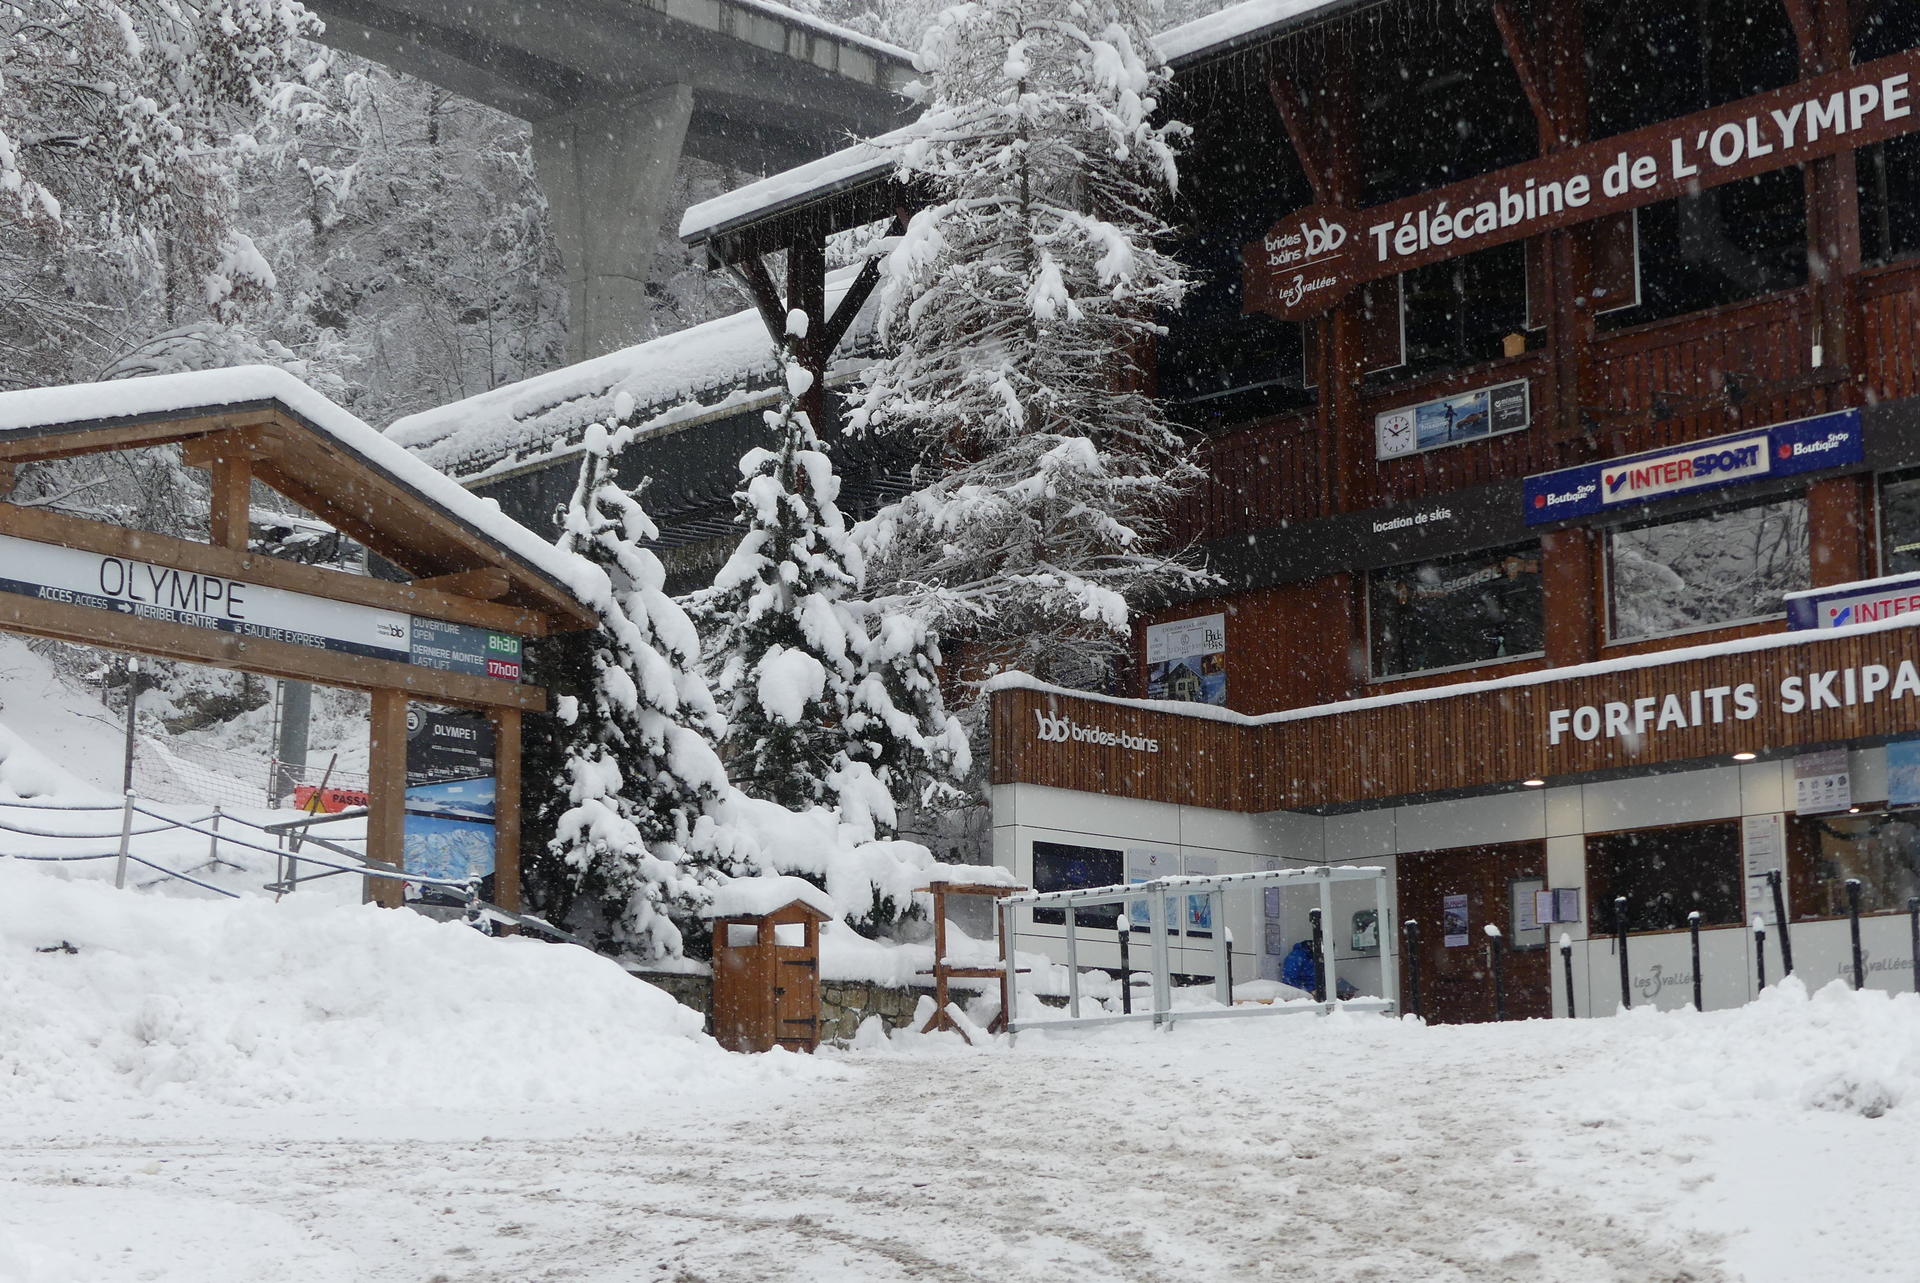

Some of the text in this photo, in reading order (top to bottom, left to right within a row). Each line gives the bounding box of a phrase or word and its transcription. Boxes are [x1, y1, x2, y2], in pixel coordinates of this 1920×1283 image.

[1369, 73, 1911, 262] Télécabine de L'OLYMPE
[1264, 232, 1301, 252] brides
[1793, 432, 1849, 456] Boutique Shop
[1629, 444, 1760, 490] INTERSPORT
[1547, 483, 1596, 506] Boutique Shop
[1372, 507, 1452, 533] location de skis
[100, 557, 246, 619] OLYMPE
[38, 586, 326, 649] ACCES ACCESS MERIBEL CENTRE SAULIRE EXPRESS
[413, 617, 460, 635] OUVERTURE
[413, 628, 435, 641] OPEN
[489, 635, 518, 654] 8h30
[412, 643, 484, 666] DERNIERE MONTEE
[412, 655, 450, 671] LAST LIFT
[488, 661, 519, 678] 17h00
[1549, 660, 1920, 745] FORFAITS SKIPA
[434, 724, 477, 740] OLYMPE 1
